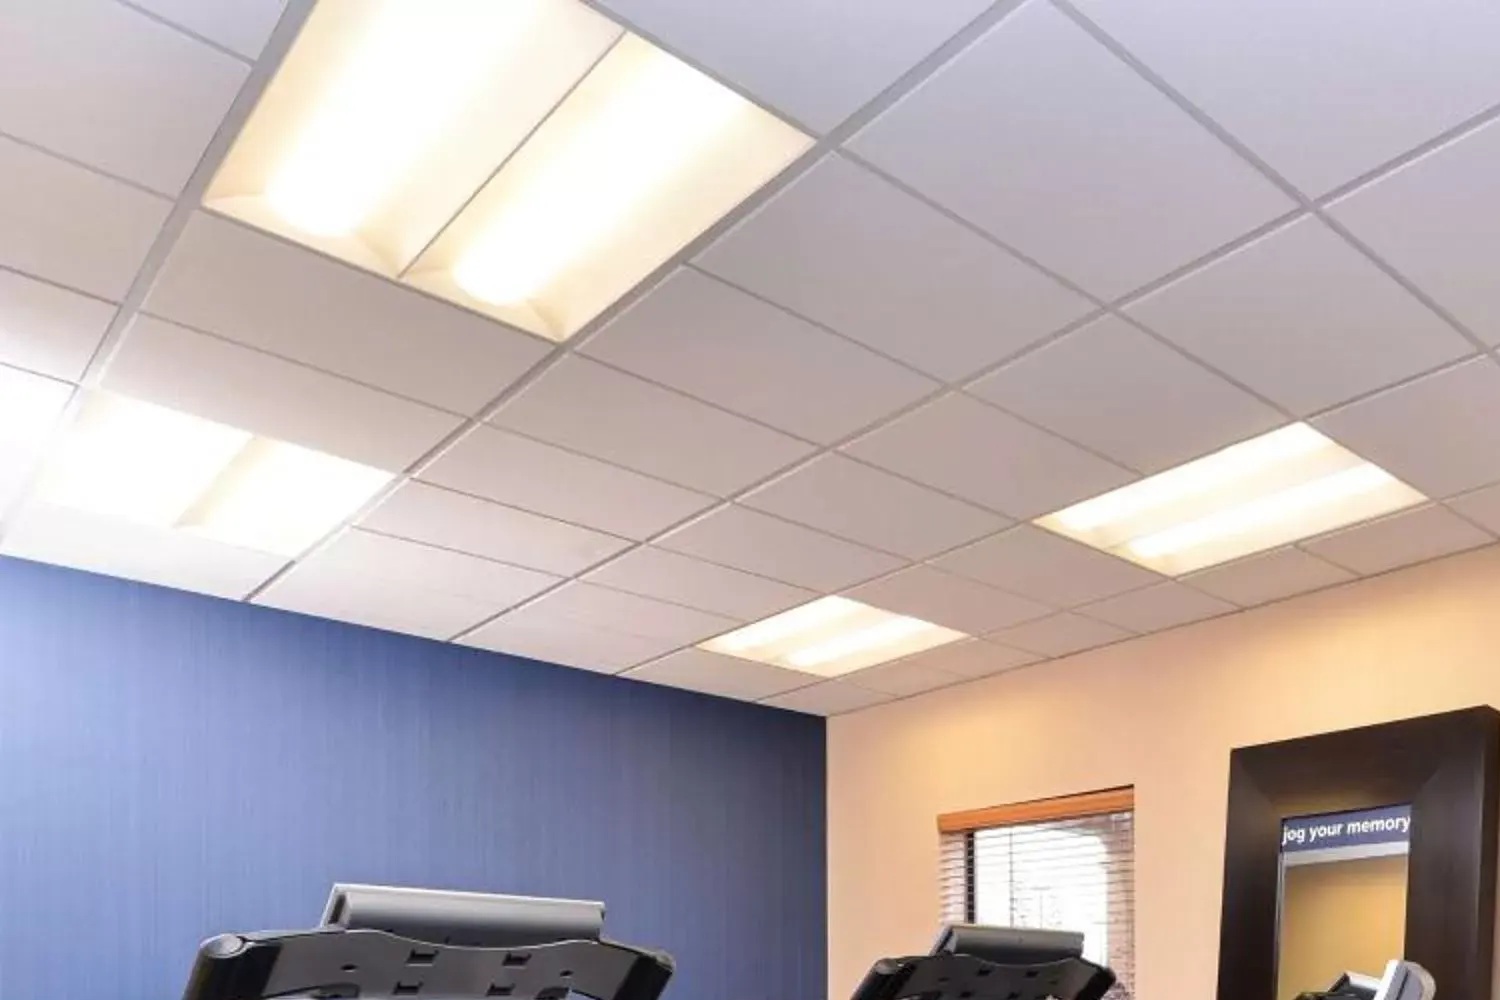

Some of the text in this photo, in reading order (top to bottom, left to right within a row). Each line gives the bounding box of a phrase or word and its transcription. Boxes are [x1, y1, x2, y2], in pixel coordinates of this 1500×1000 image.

[1282, 816, 1411, 846] jog your memory
